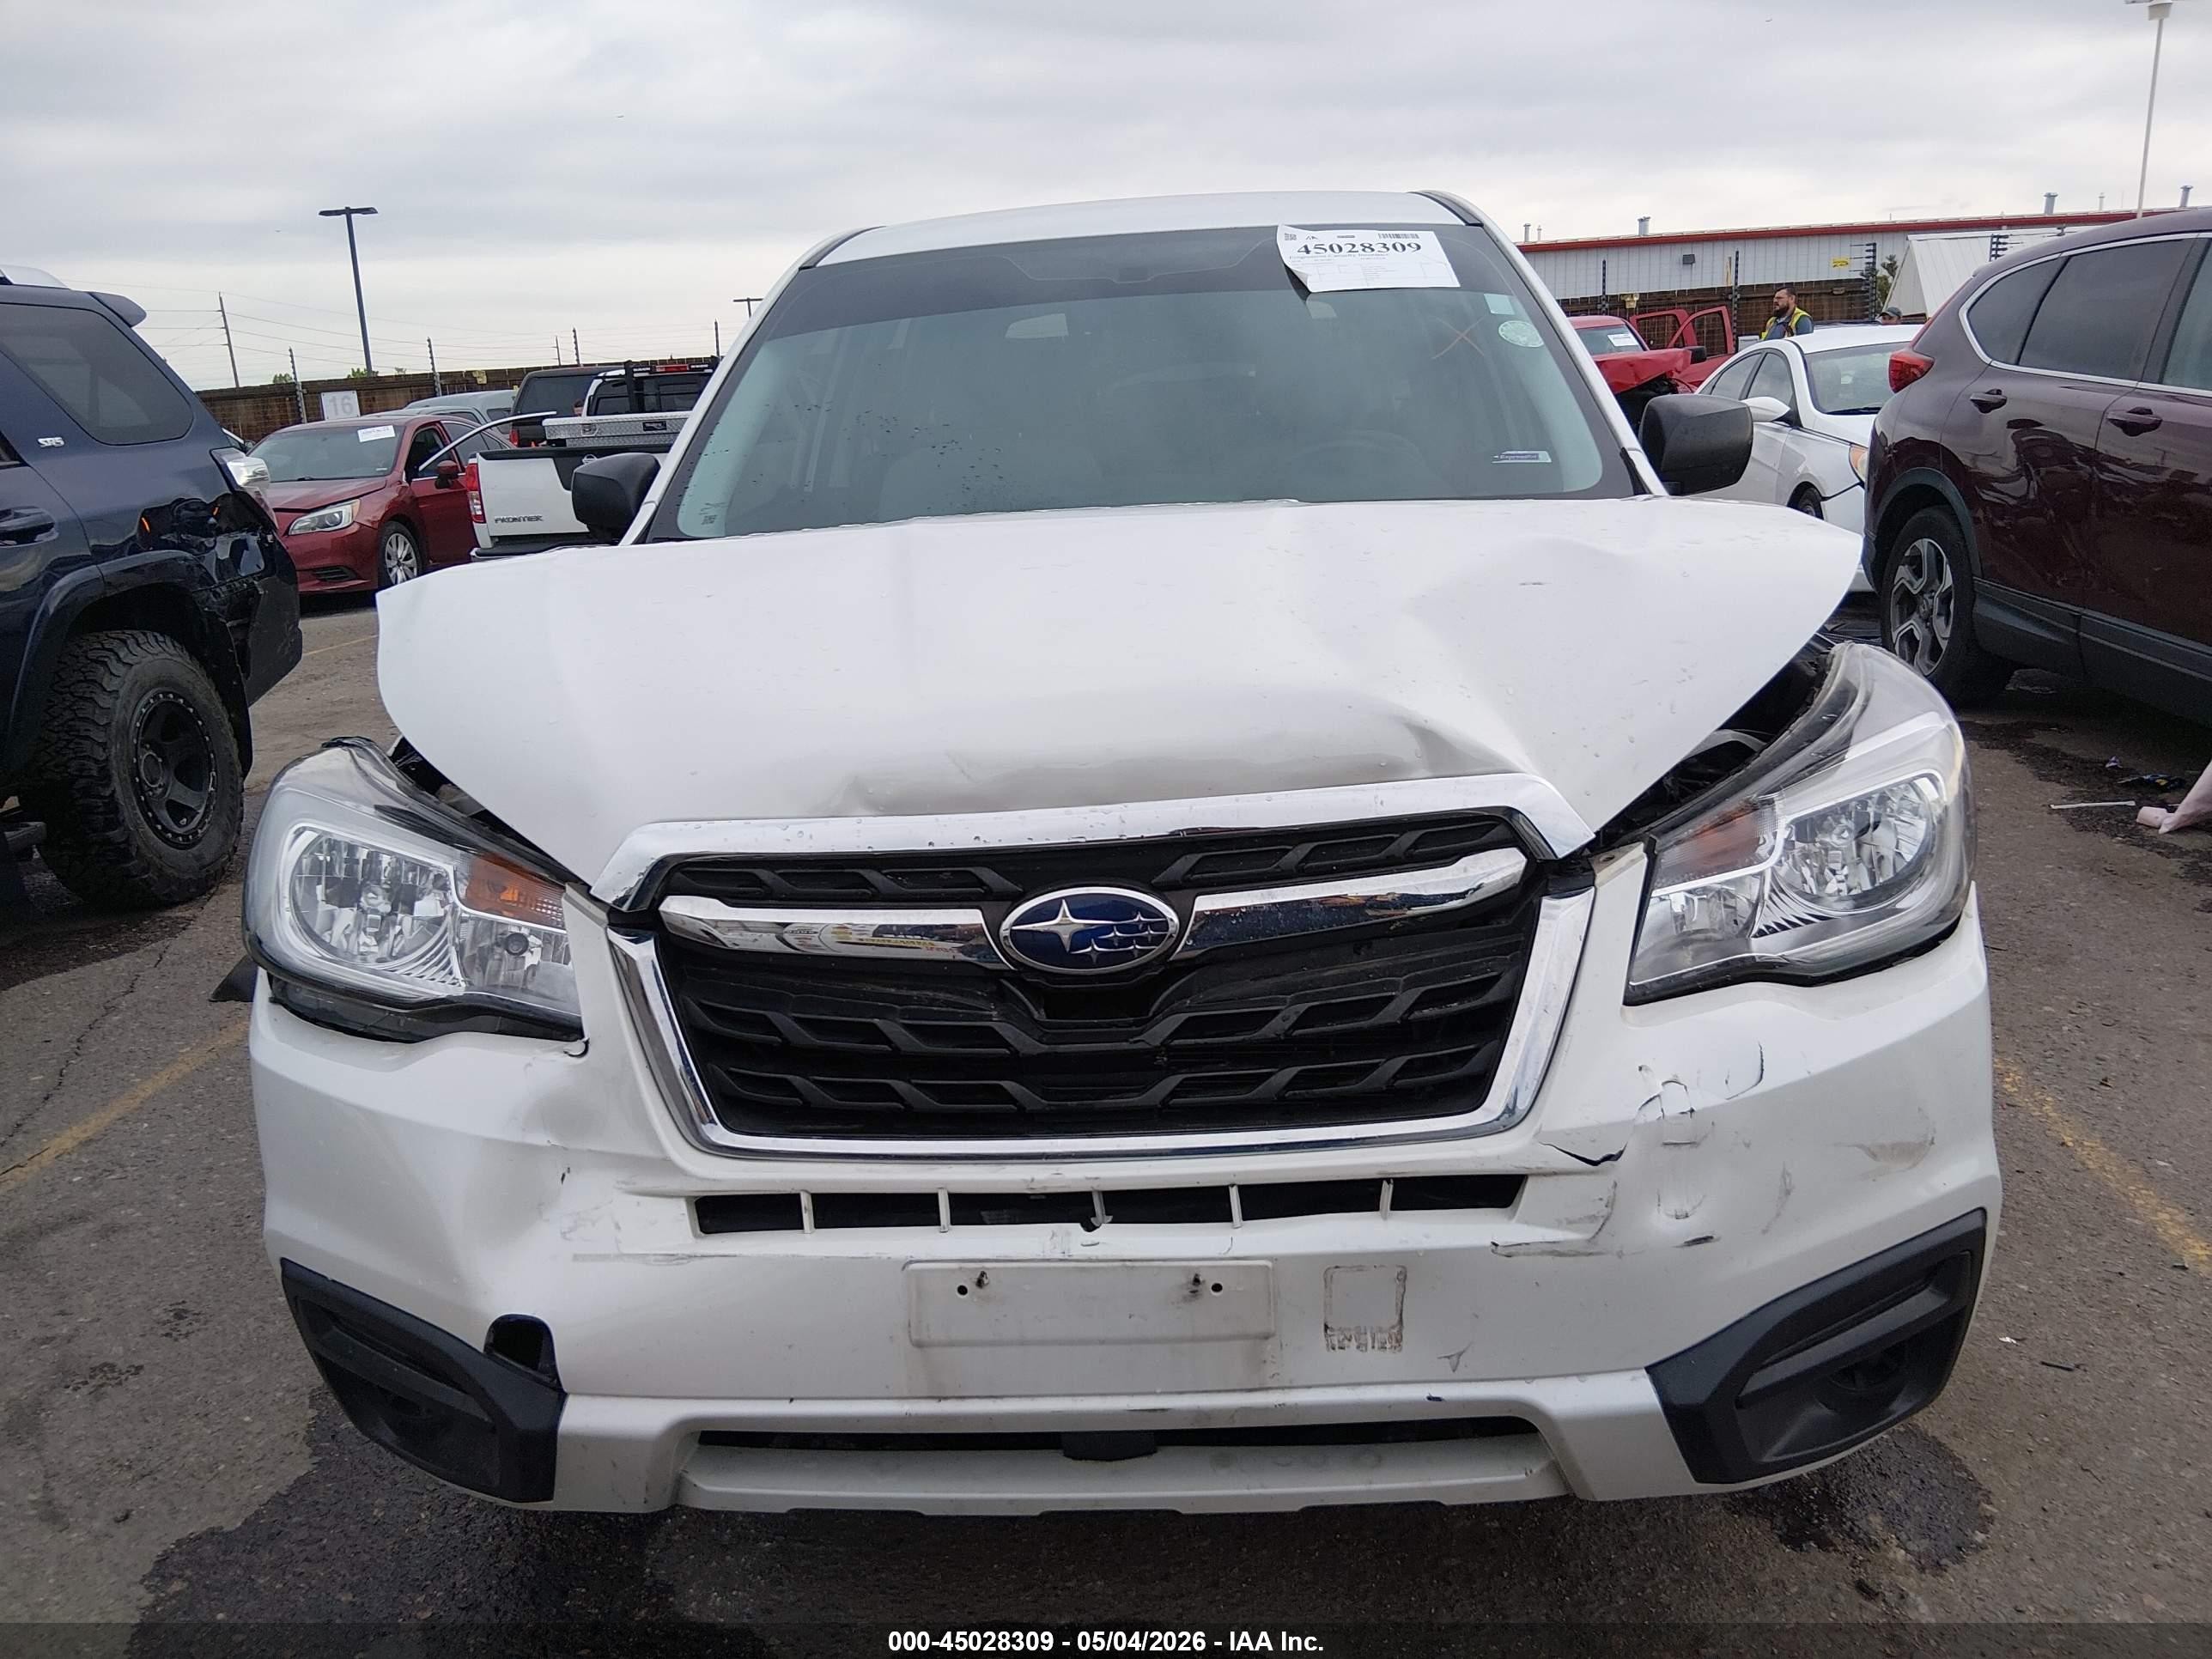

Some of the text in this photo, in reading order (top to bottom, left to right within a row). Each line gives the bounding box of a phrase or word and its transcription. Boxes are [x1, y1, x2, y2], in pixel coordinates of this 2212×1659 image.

[1297, 241, 1422, 255] 45028309
[329, 395, 354, 416] 16
[38, 436, 65, 447] SR5
